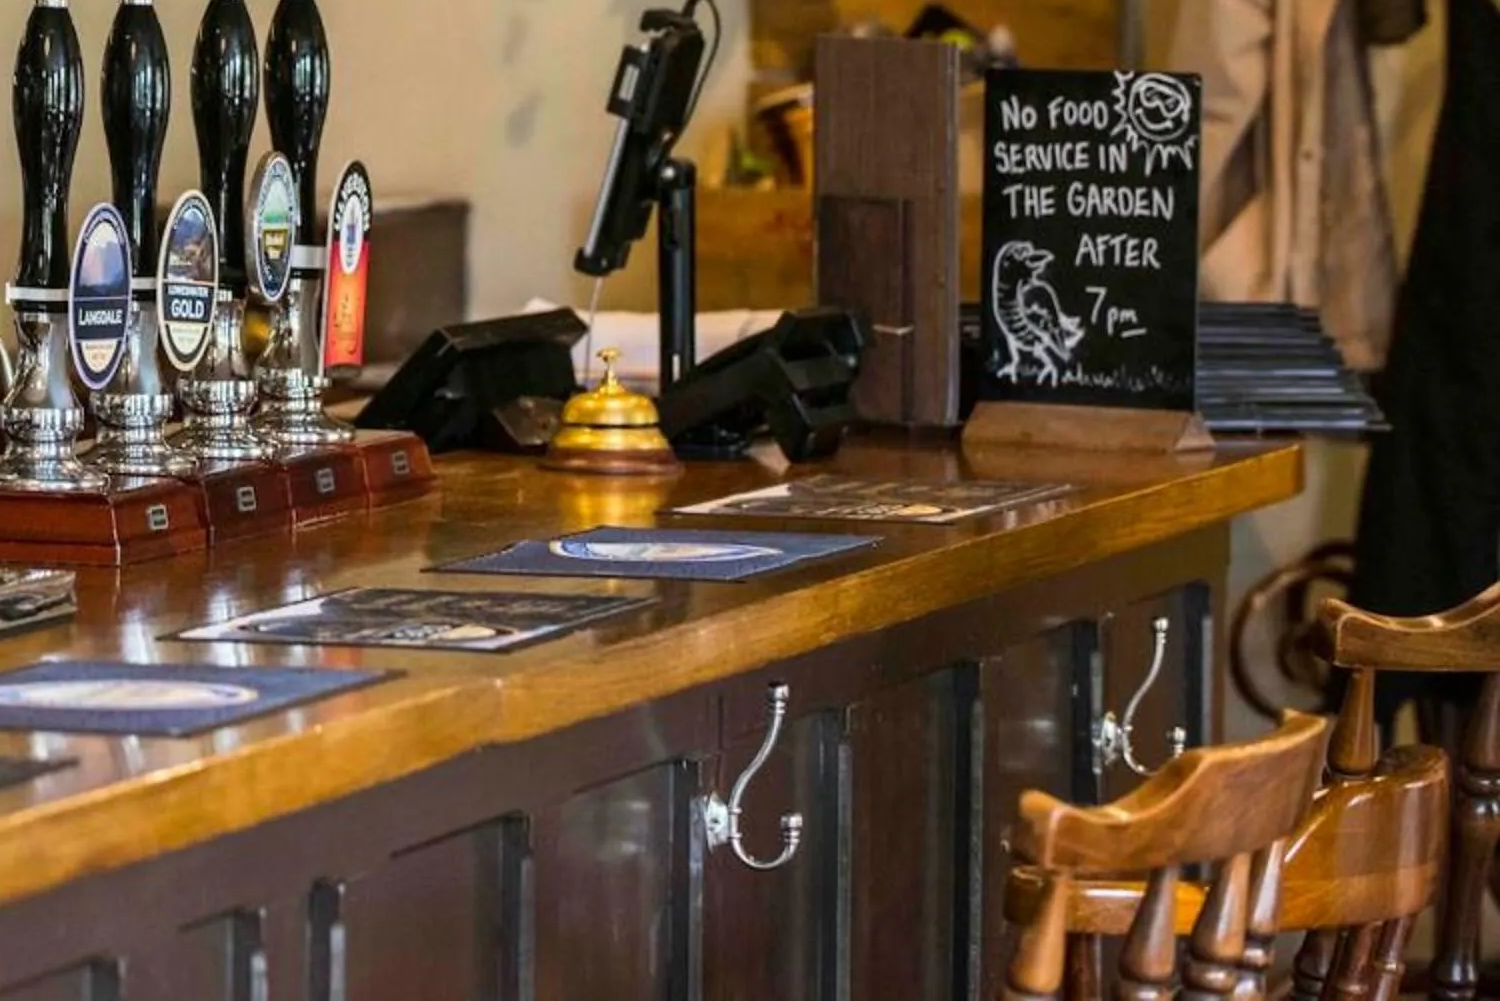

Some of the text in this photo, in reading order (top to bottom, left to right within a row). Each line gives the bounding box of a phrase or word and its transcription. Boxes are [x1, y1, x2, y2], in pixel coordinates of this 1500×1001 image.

[1048, 95, 1108, 129] FOOD
[994, 142, 1129, 174] SERVICE IN
[1002, 181, 1174, 221] THE GARDEN
[1075, 233, 1161, 269] AFTER
[78, 307, 123, 326] LANGDALE
[171, 299, 205, 319] GOLD
